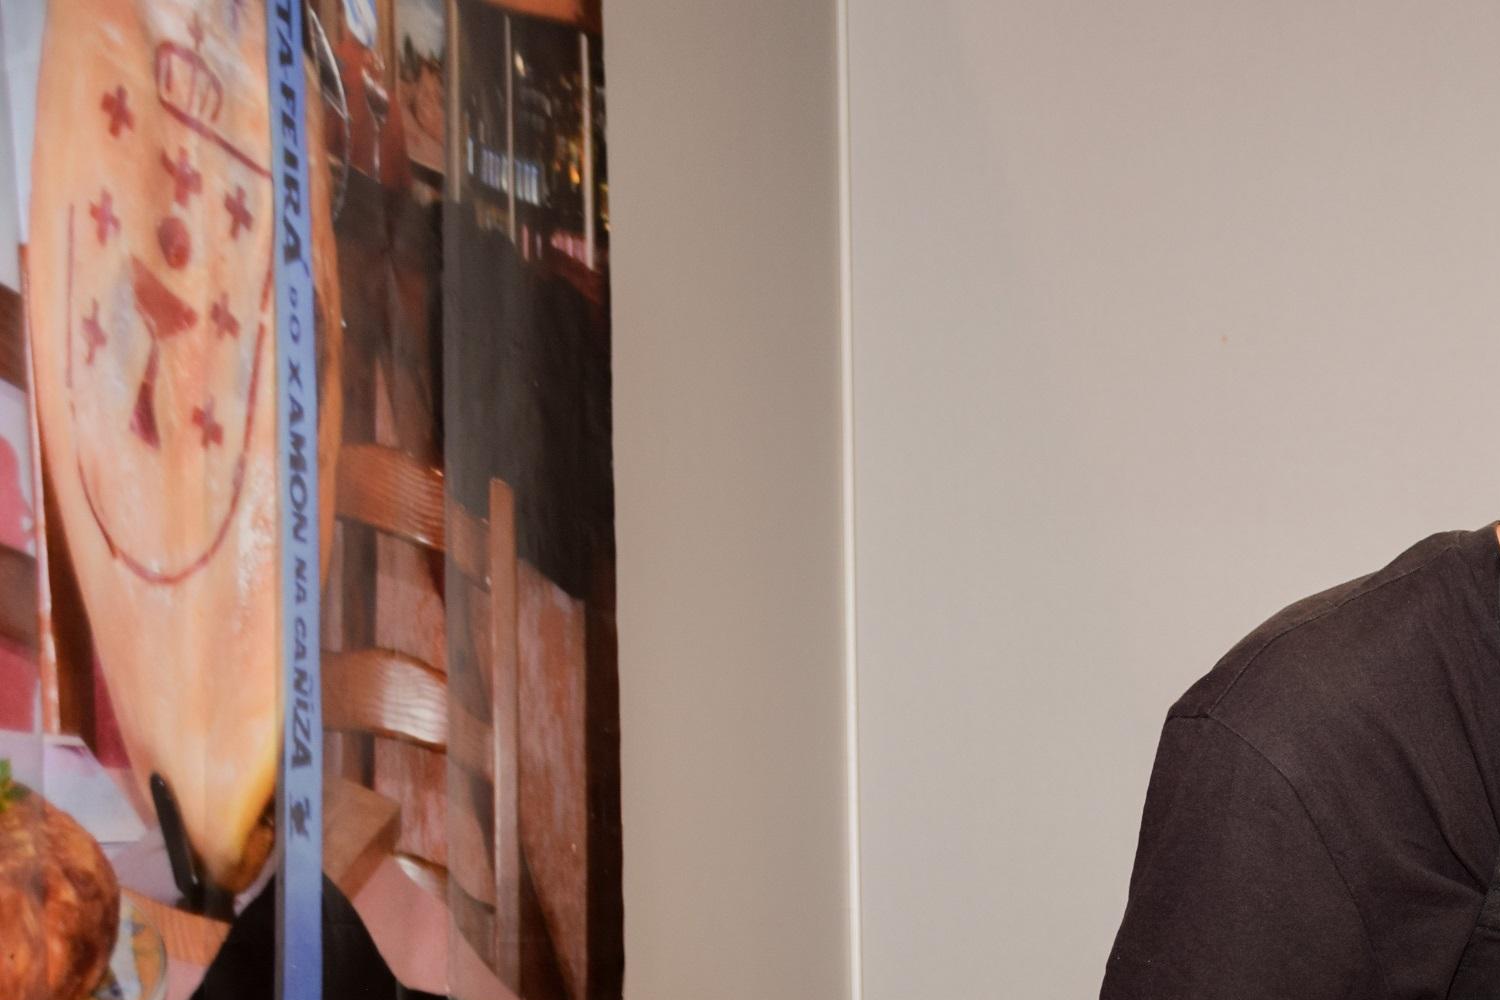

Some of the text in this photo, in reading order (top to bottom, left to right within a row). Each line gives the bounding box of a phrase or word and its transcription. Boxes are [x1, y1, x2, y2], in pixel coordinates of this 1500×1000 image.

[288, 283, 301, 345] DO
[288, 355, 308, 544] XAMON
[294, 557, 308, 605] NA
